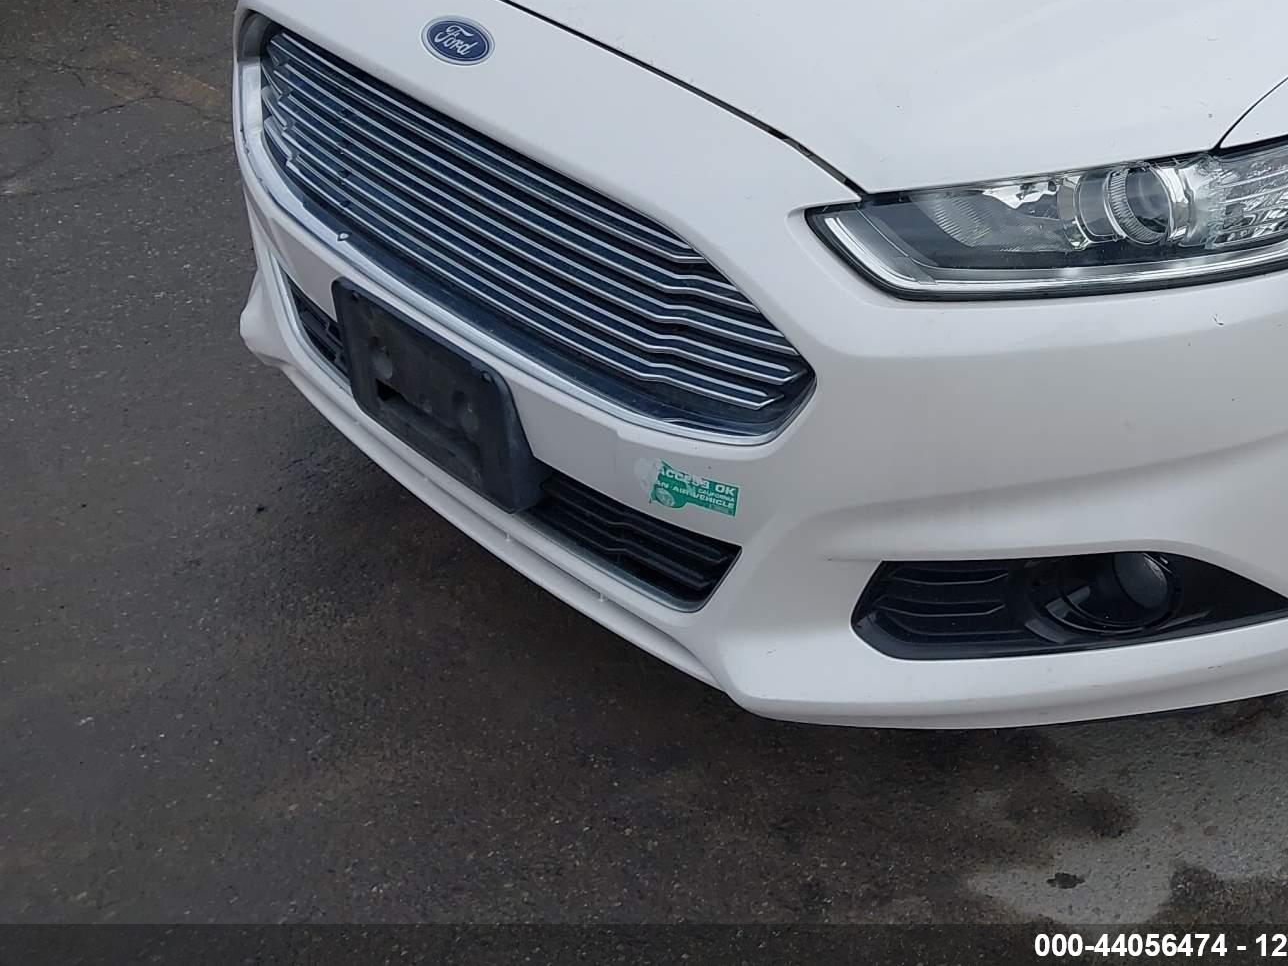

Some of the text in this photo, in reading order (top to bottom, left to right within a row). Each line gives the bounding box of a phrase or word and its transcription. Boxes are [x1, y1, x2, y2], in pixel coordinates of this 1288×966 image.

[434, 25, 479, 55] Ford
[715, 484, 737, 497] OK
[693, 493, 736, 510] VEHICLE
